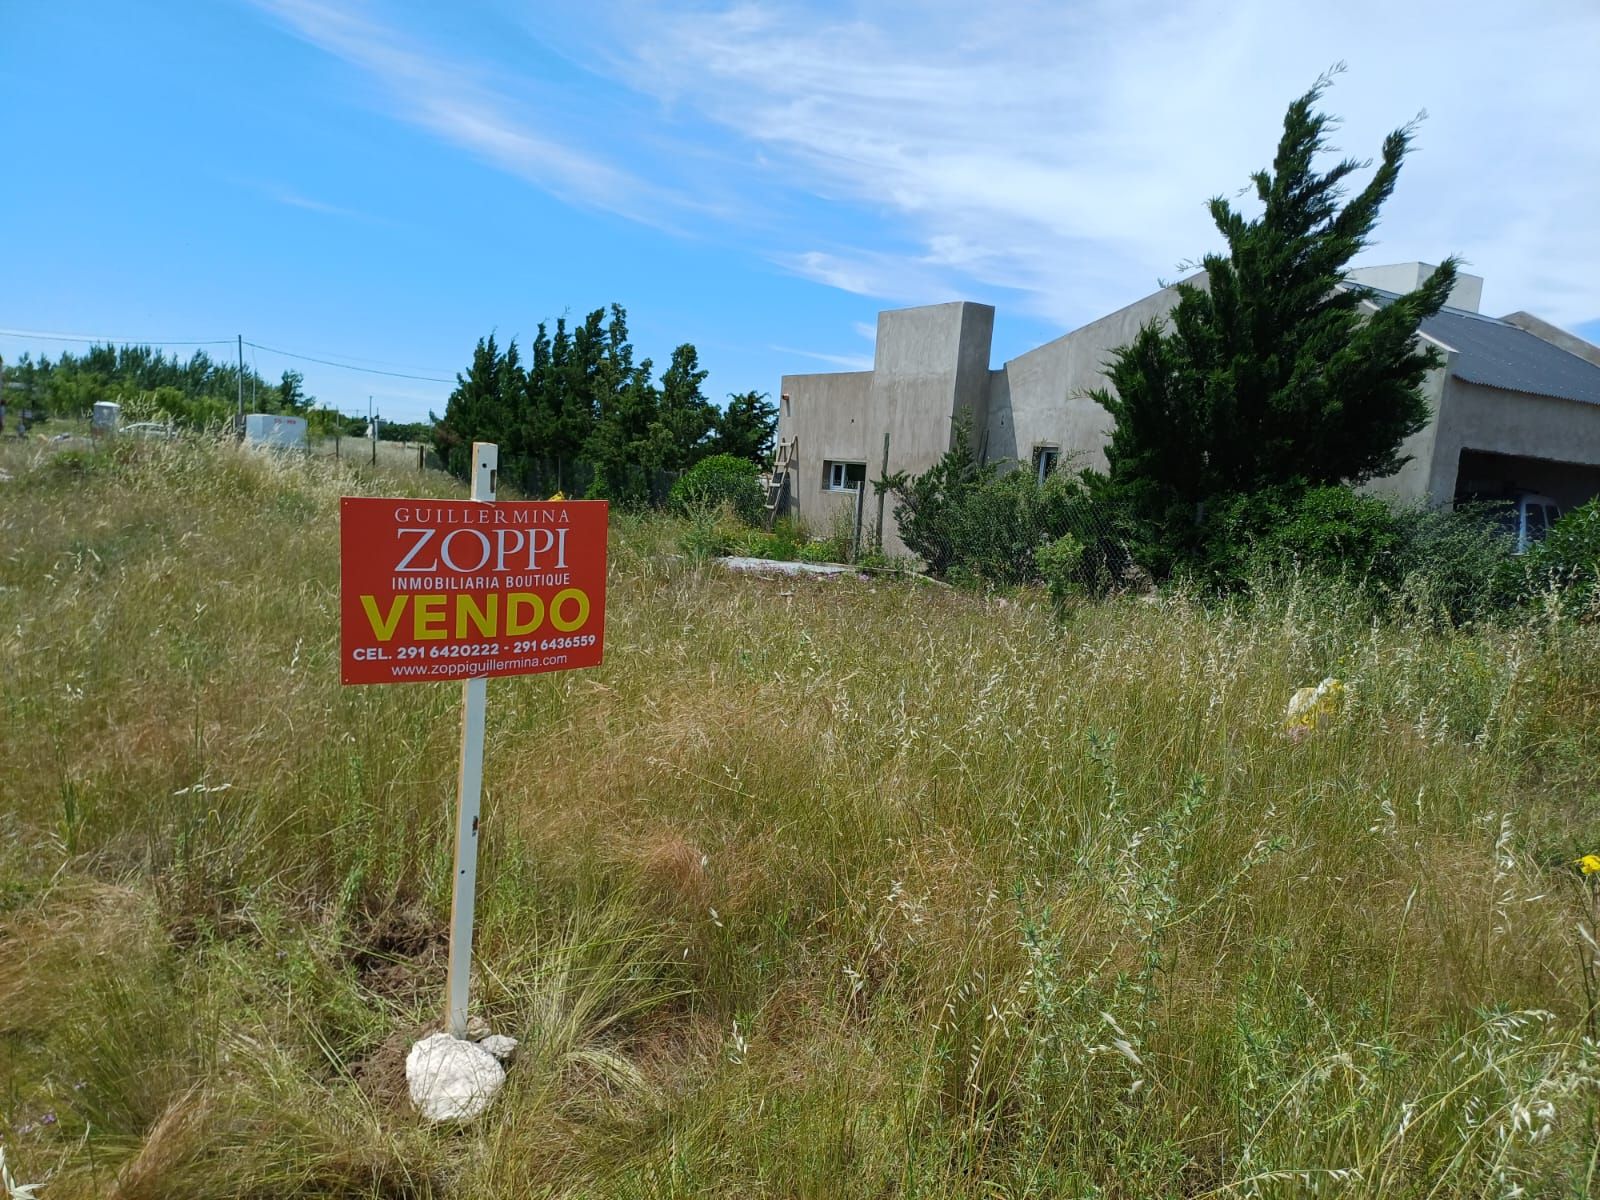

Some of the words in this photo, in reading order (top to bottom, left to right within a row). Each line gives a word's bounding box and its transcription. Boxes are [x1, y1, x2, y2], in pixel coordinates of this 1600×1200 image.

[394, 507, 570, 524] GUILLERMINA
[394, 528, 570, 573] ZOPPI
[392, 576, 500, 590] INMOBILIARIA
[505, 573, 570, 588] BOUTIQUE
[360, 588, 590, 642] VENDO
[352, 647, 392, 661] CEL.
[397, 646, 425, 659] 291
[429, 643, 499, 658] 6420222
[513, 640, 537, 654] 291
[540, 635, 596, 652] 6436559
[391, 653, 567, 677] www.zoppiguillermina.com
